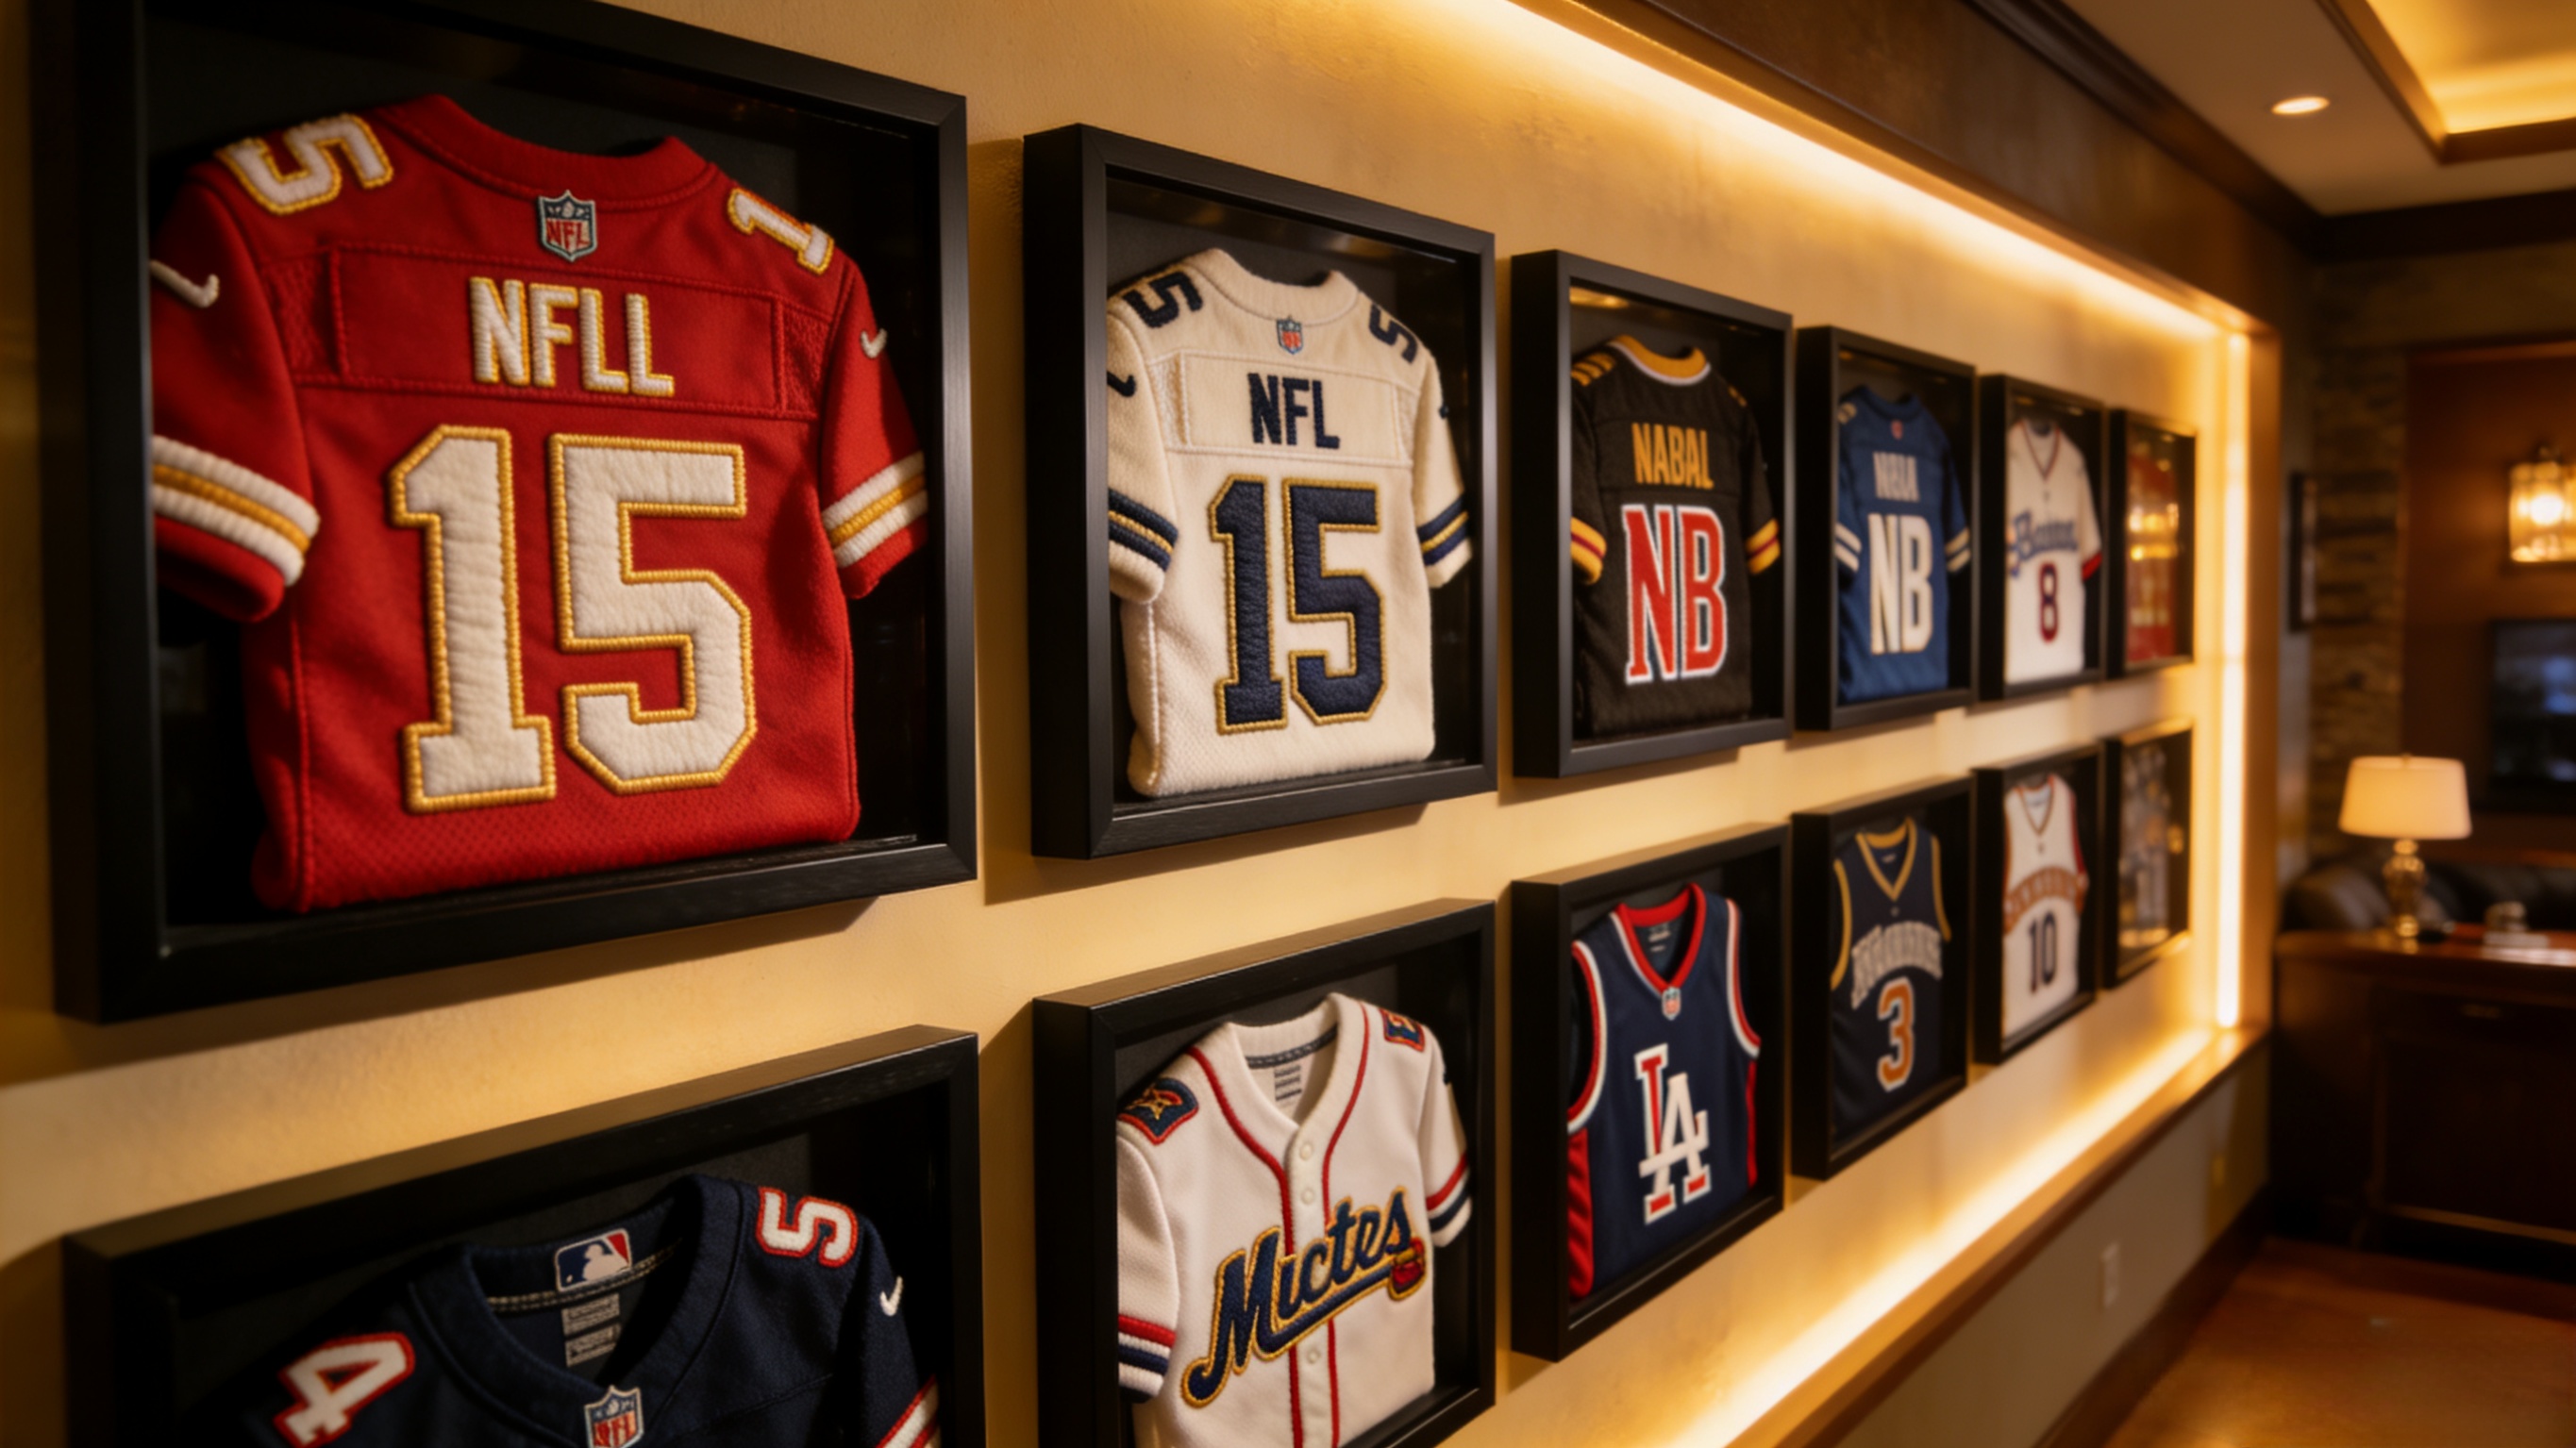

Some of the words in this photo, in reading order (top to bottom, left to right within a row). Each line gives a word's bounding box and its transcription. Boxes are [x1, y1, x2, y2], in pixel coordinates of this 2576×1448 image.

[544, 220, 589, 249] NFL
[728, 188, 835, 275] 1
[470, 276, 676, 396] NFLL
[1247, 373, 1340, 449] NFL
[1631, 422, 1715, 491] NABAL
[388, 424, 757, 815] 15
[1207, 474, 1388, 736] 15
[1621, 504, 1728, 684] NB
[1867, 512, 1933, 656] NB
[2038, 560, 2059, 643] 8
[2028, 909, 2058, 996] 10
[1877, 975, 1915, 1092] 3
[1634, 1043, 1712, 1225] LA
[757, 1187, 858, 1268] 5
[1180, 1186, 1415, 1407] Mictes
[273, 1332, 416, 1448] 4
